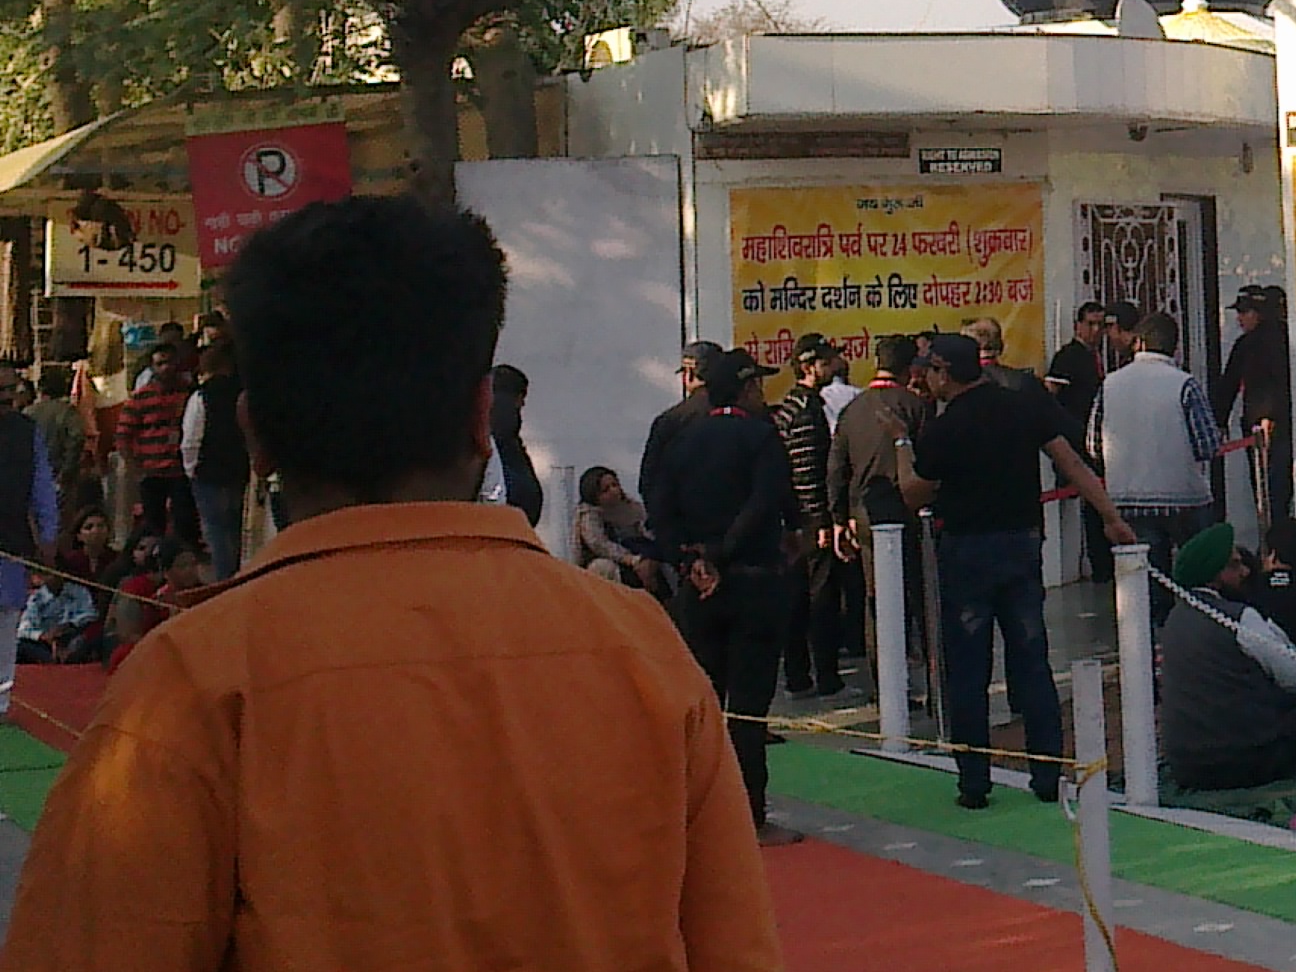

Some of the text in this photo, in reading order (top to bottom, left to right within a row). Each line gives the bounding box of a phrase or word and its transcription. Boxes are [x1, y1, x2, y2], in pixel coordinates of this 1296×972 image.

[742, 223, 835, 264] महाशिवरात्रि
[838, 222, 863, 259] पर्व
[866, 233, 889, 258] पर
[892, 232, 907, 257] 24
[912, 220, 961, 256] फरवरी
[742, 279, 765, 312] को
[769, 276, 818, 311] मन्दिर
[820, 274, 862, 309] दर्शन
[865, 274, 884, 309] के
[888, 272, 918, 309] लिए
[922, 273, 972, 308] दोपहर
